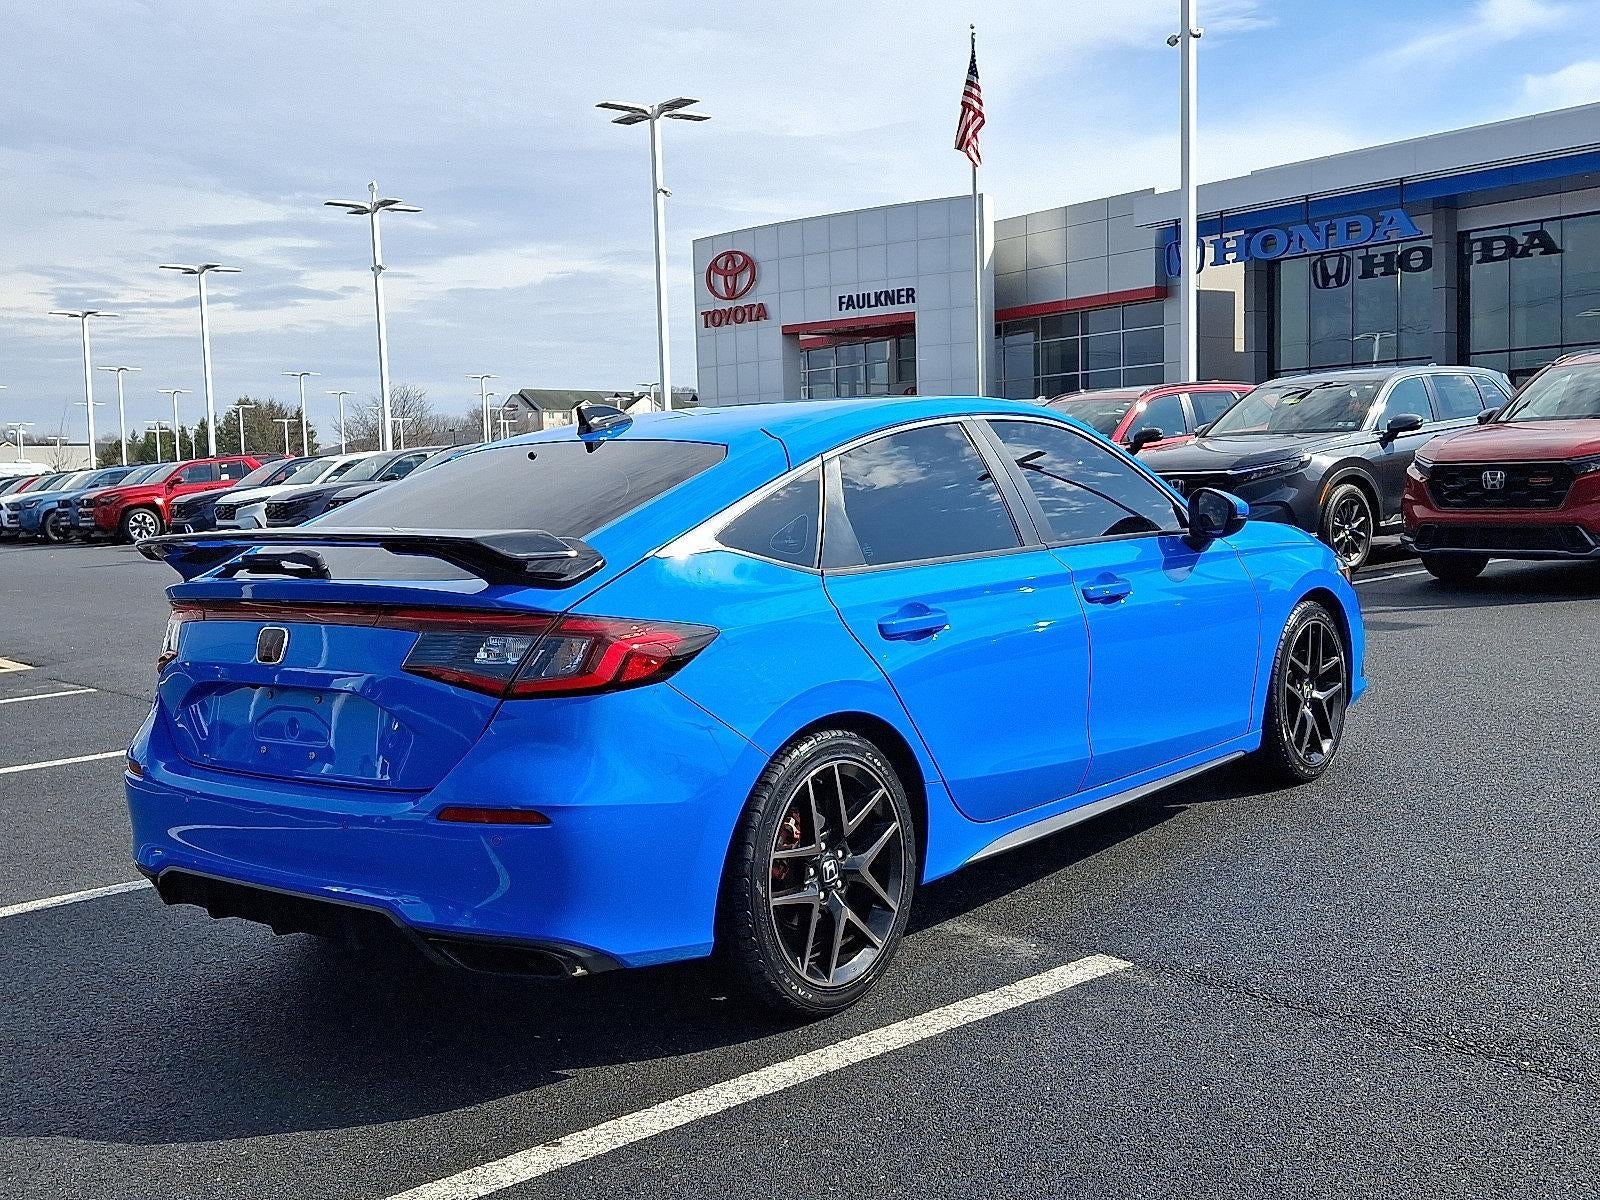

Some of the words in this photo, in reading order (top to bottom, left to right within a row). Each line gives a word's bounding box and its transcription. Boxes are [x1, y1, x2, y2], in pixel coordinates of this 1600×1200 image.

[1209, 208, 1423, 267] HONDA
[838, 287, 916, 311] FAULKNER
[701, 302, 768, 328] TOYOTA
